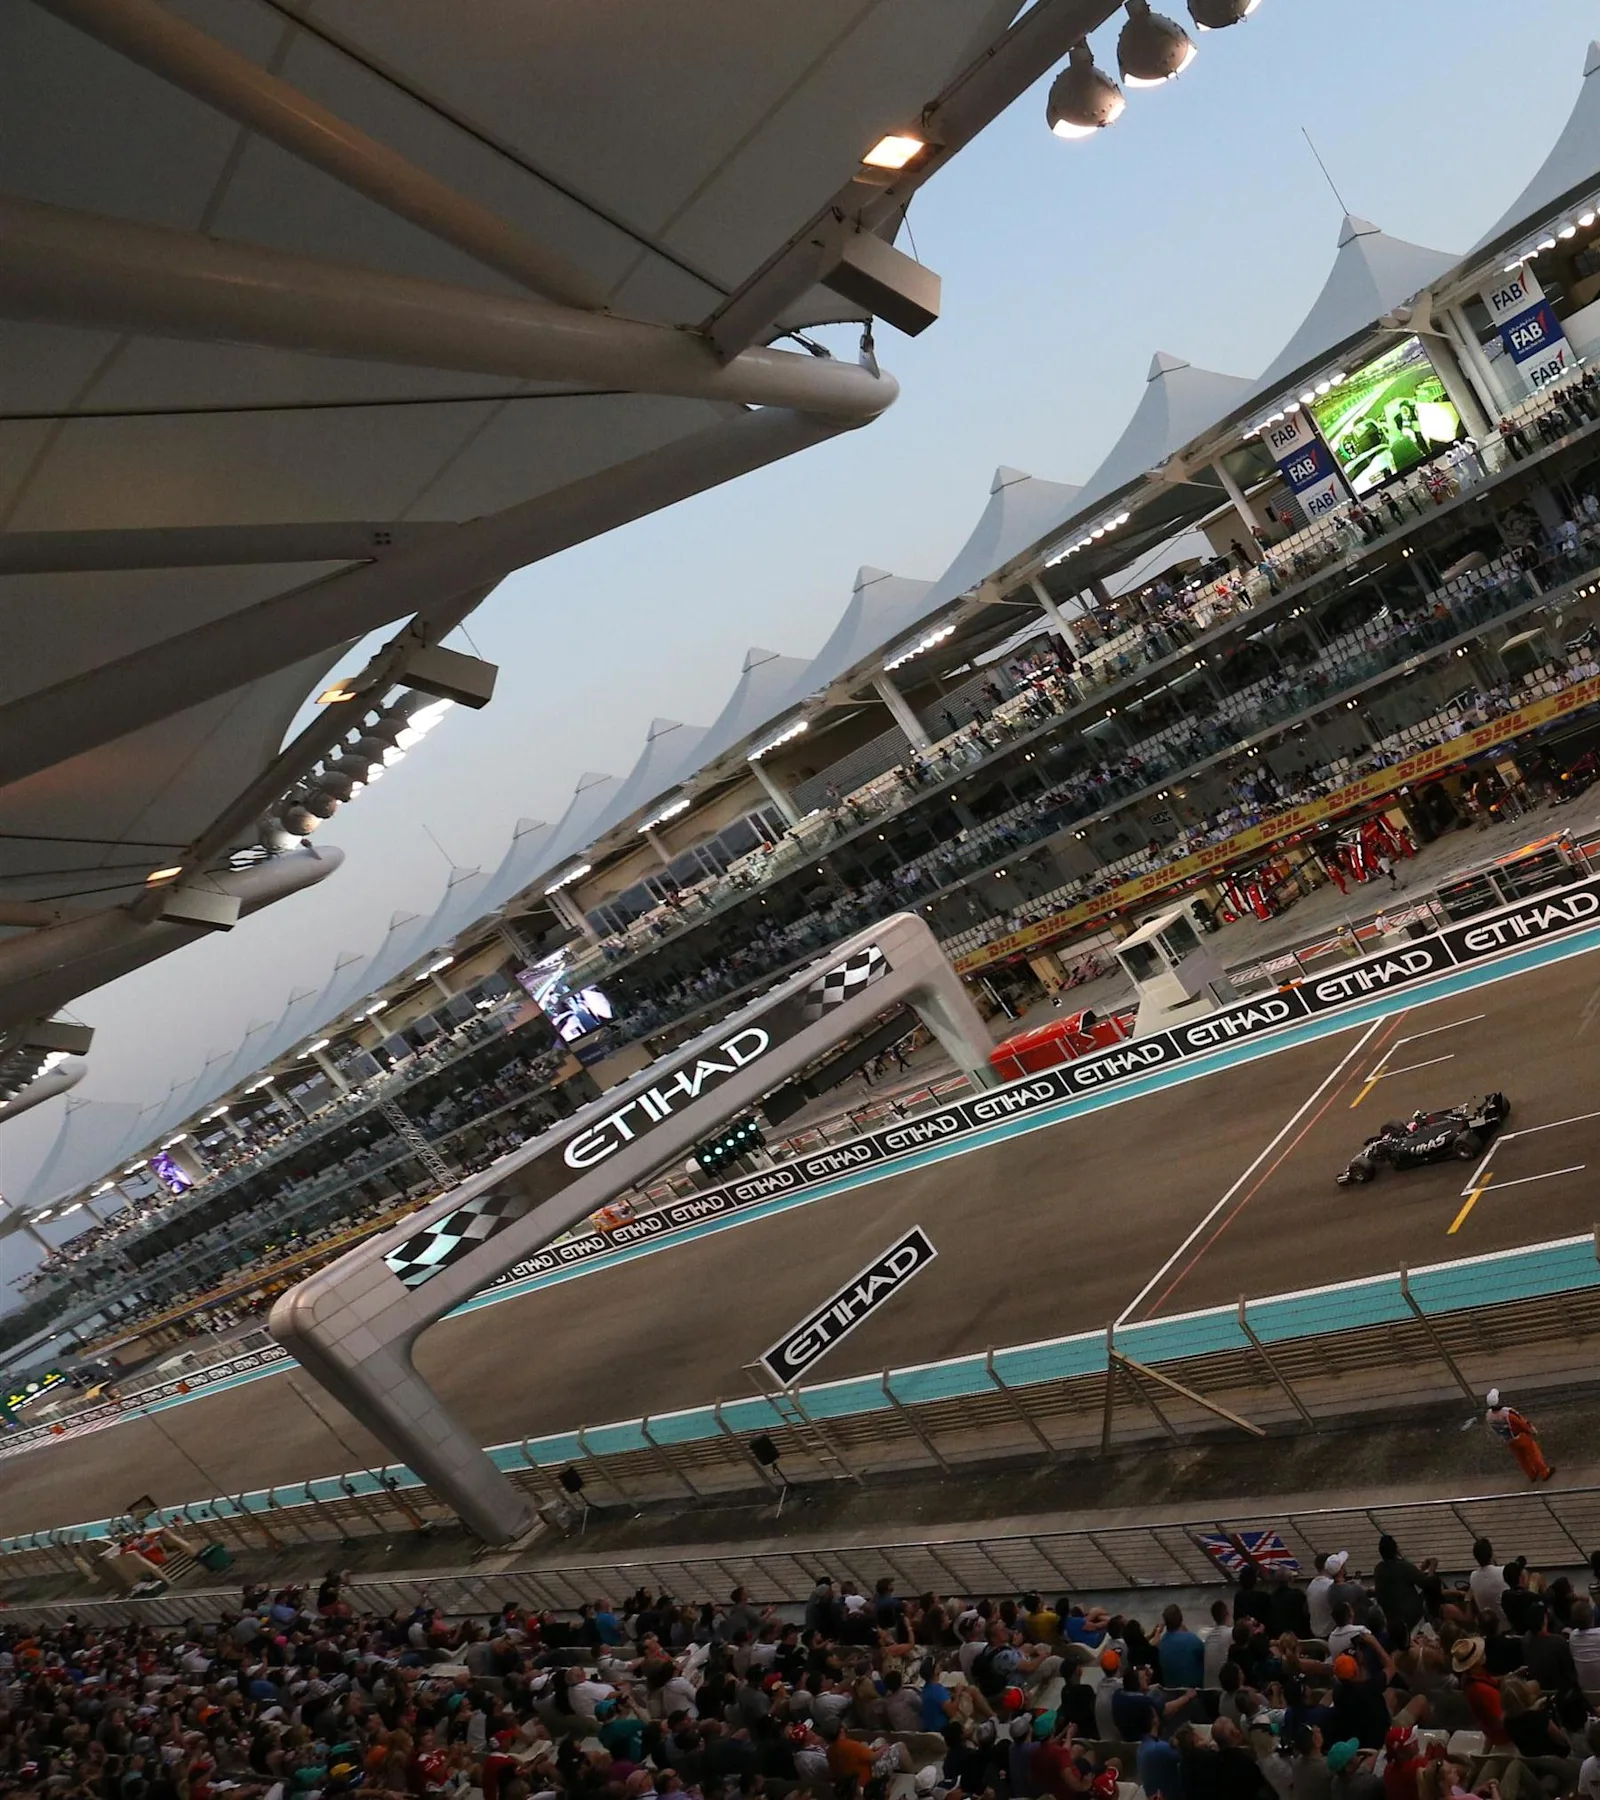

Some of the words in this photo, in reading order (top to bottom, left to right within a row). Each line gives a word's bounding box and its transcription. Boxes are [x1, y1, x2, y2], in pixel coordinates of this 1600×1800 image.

[1492, 283, 1523, 311] FAB
[1511, 321, 1543, 350] FAB
[1530, 360, 1561, 387] FAB
[1270, 424, 1296, 448] FAB
[1288, 457, 1316, 483] FAB
[1308, 492, 1334, 516] FAB
[1472, 713, 1530, 749] DHL
[1396, 746, 1450, 780] DHL
[1326, 780, 1376, 810] DHL
[1260, 810, 1307, 838] DHL
[1197, 840, 1242, 865] DHL
[1140, 864, 1182, 891] DHL
[1085, 891, 1125, 915] DHL
[1035, 914, 1072, 937] DHL
[1464, 892, 1599, 951] ETIHAD
[985, 936, 1021, 958] DHL
[1315, 950, 1433, 1002] ETIHAD
[1187, 1000, 1290, 1047] ETIHAD
[1074, 1043, 1165, 1085] ETIHAD
[564, 1027, 769, 1169] ETIHAD
[974, 1082, 1055, 1121] ETIHAD
[885, 1115, 959, 1149] ETIHAD
[806, 1144, 872, 1176] ETIHAD
[735, 1171, 795, 1200] ETIHAD
[671, 1195, 725, 1222] ETIHAD
[612, 1218, 663, 1243] ETIHAD
[560, 1237, 606, 1260] ETIHAD
[784, 1246, 919, 1366] ETIHAD
